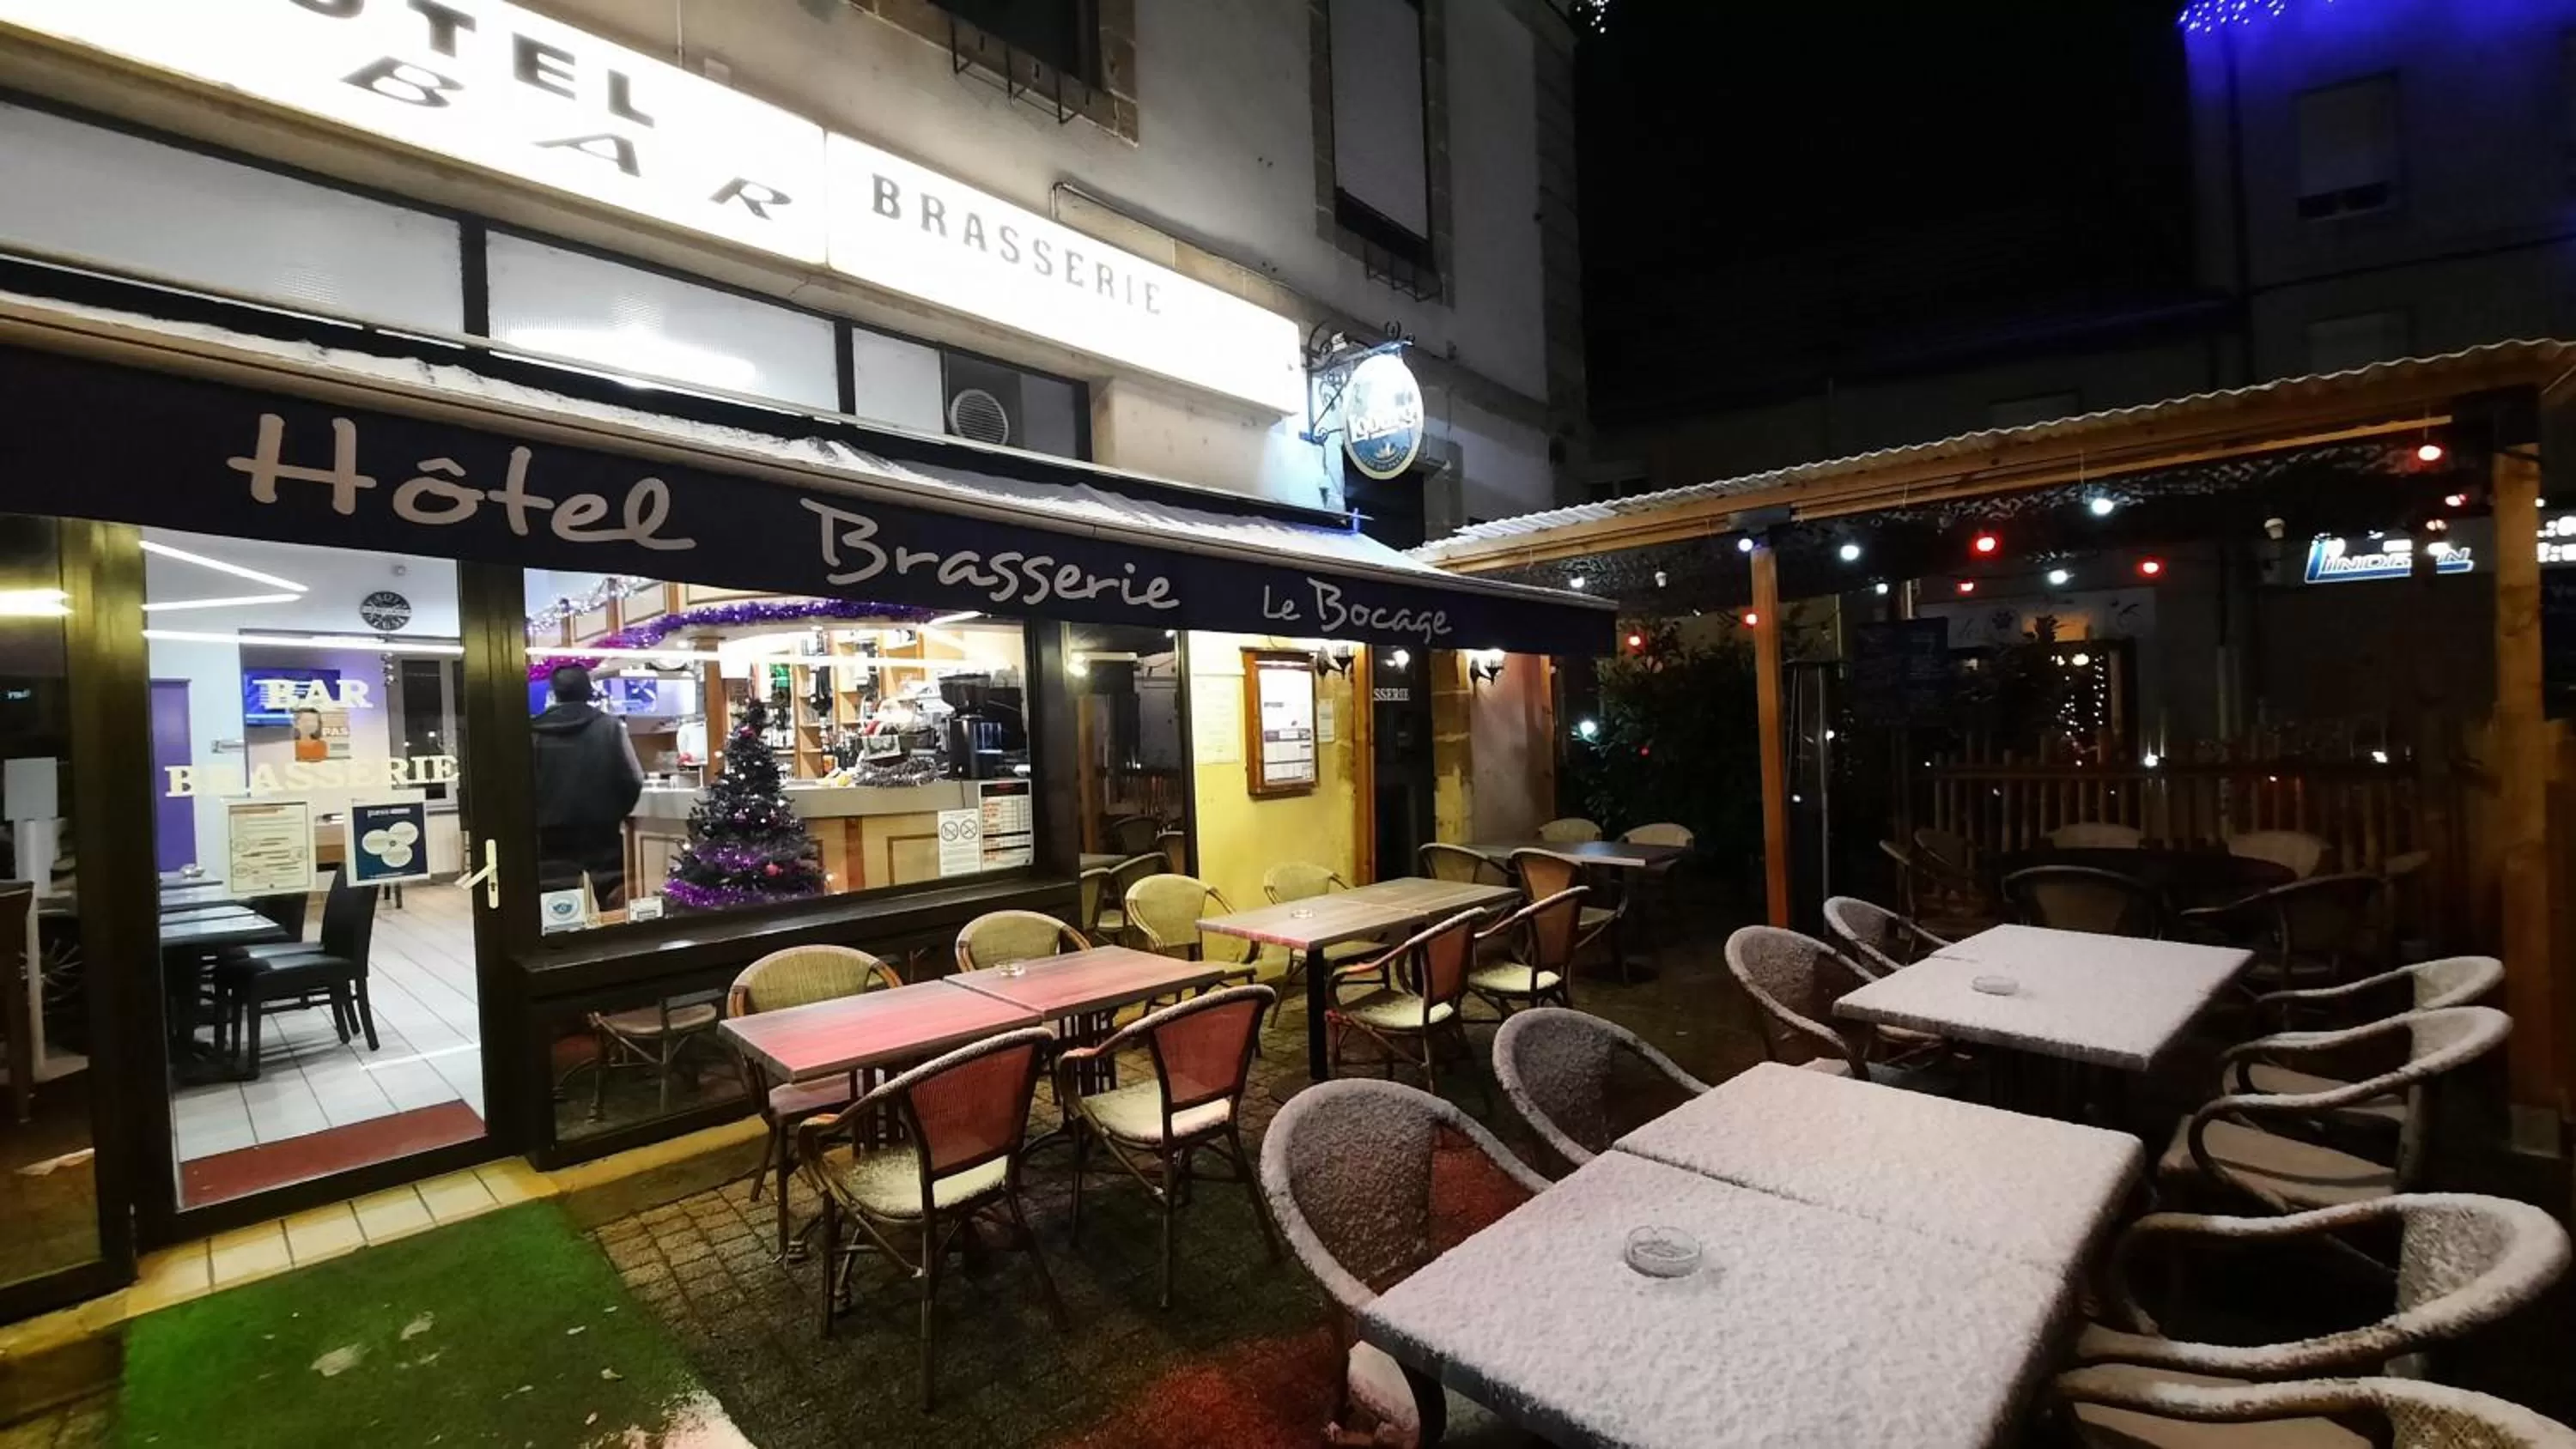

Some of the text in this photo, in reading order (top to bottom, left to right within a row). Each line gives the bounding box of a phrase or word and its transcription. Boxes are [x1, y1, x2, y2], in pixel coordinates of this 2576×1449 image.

[289, 0, 655, 128] TEL
[340, 54, 793, 220] BAR
[872, 173, 1163, 315] BRASSERIE
[228, 413, 1453, 637] Hôtel Brasserie Le Bocage
[254, 678, 374, 709] BAR
[164, 755, 461, 797] BASSERIE
